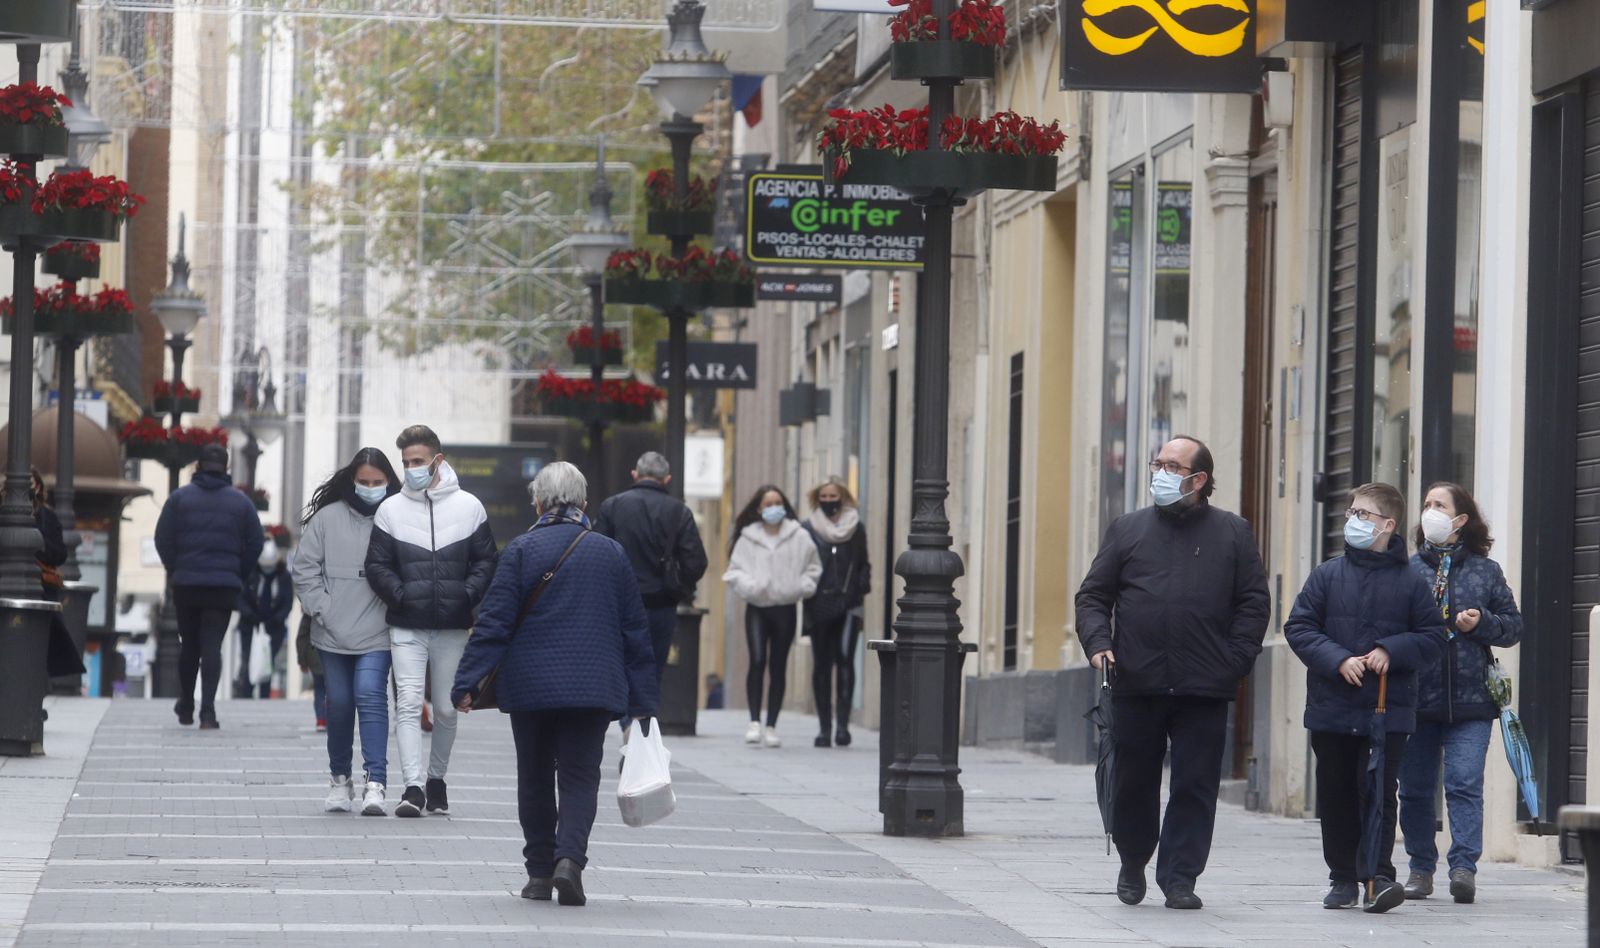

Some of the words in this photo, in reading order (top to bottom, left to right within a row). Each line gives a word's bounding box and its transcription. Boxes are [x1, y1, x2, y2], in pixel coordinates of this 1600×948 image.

[755, 179, 819, 198] AGENCIA
[824, 185, 838, 198] P.
[843, 184, 911, 200] INMOBIL
[791, 199, 901, 232] Coinfer
[775, 246, 917, 261] VENTAS-ALQUILERES
